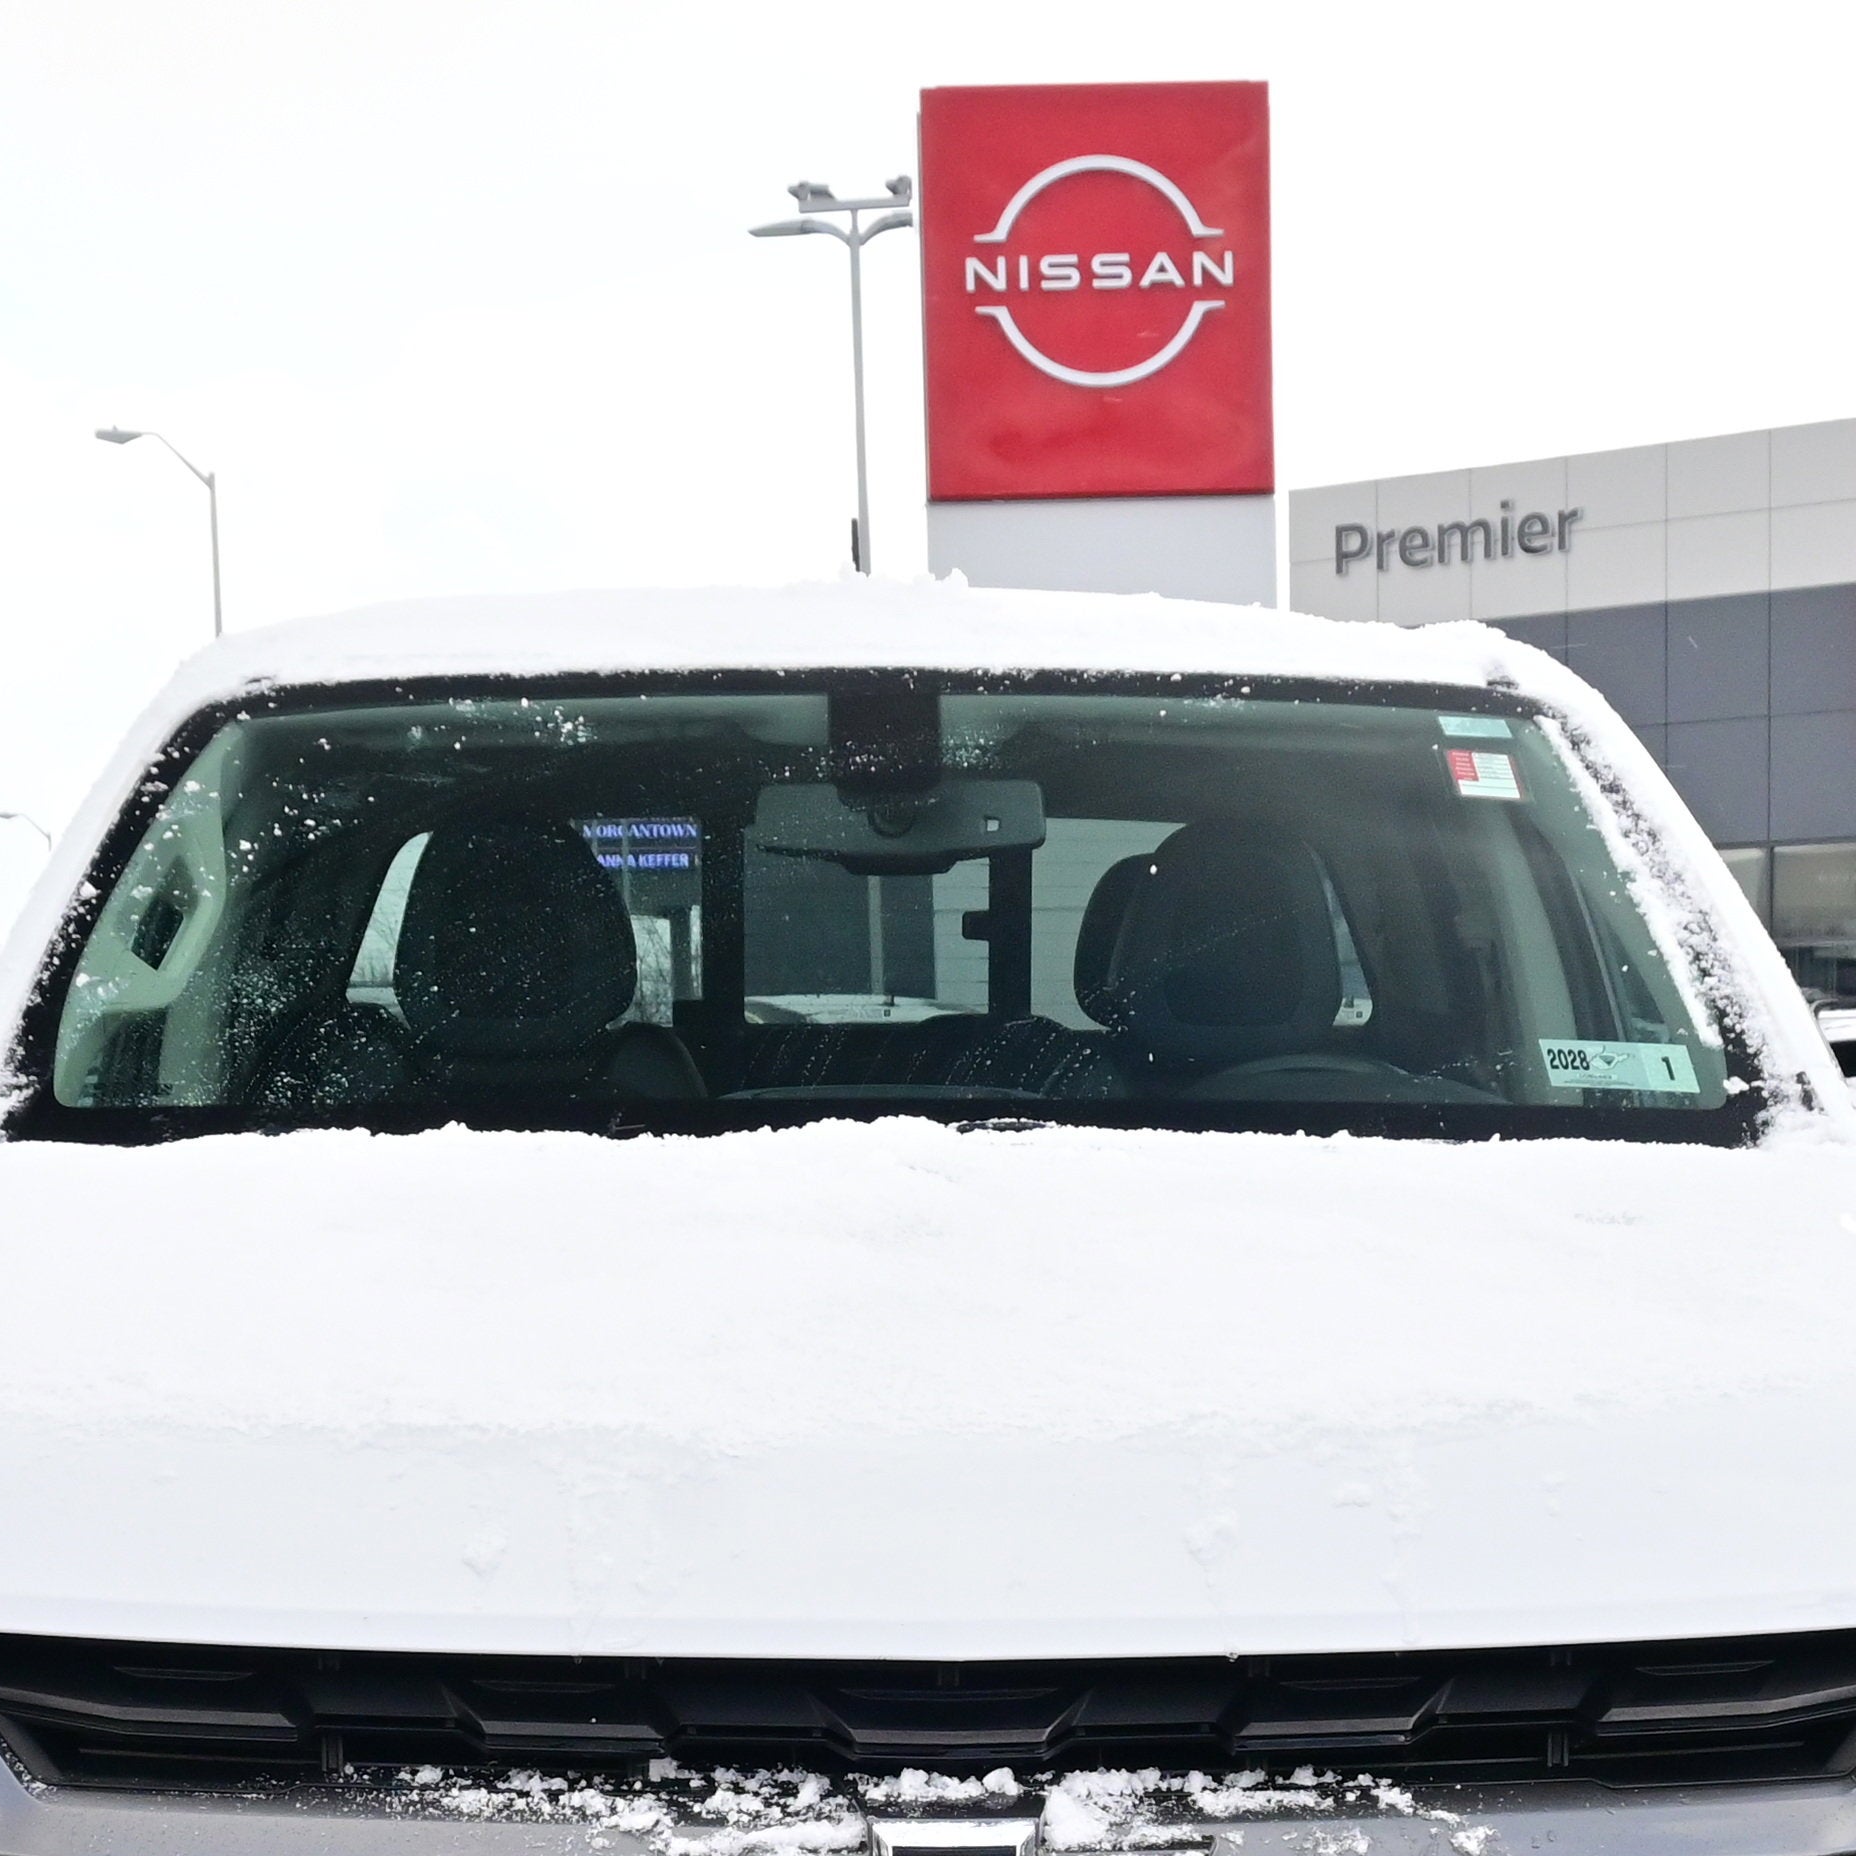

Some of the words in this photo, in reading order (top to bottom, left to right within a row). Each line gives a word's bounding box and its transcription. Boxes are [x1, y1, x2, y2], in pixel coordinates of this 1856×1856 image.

[965, 250, 1235, 293] NISSAN
[1335, 499, 1582, 575] Premier
[639, 853, 689, 867] KEFFER
[1547, 1048, 1590, 1071] 2028
[1661, 1056, 1676, 1081] 1
